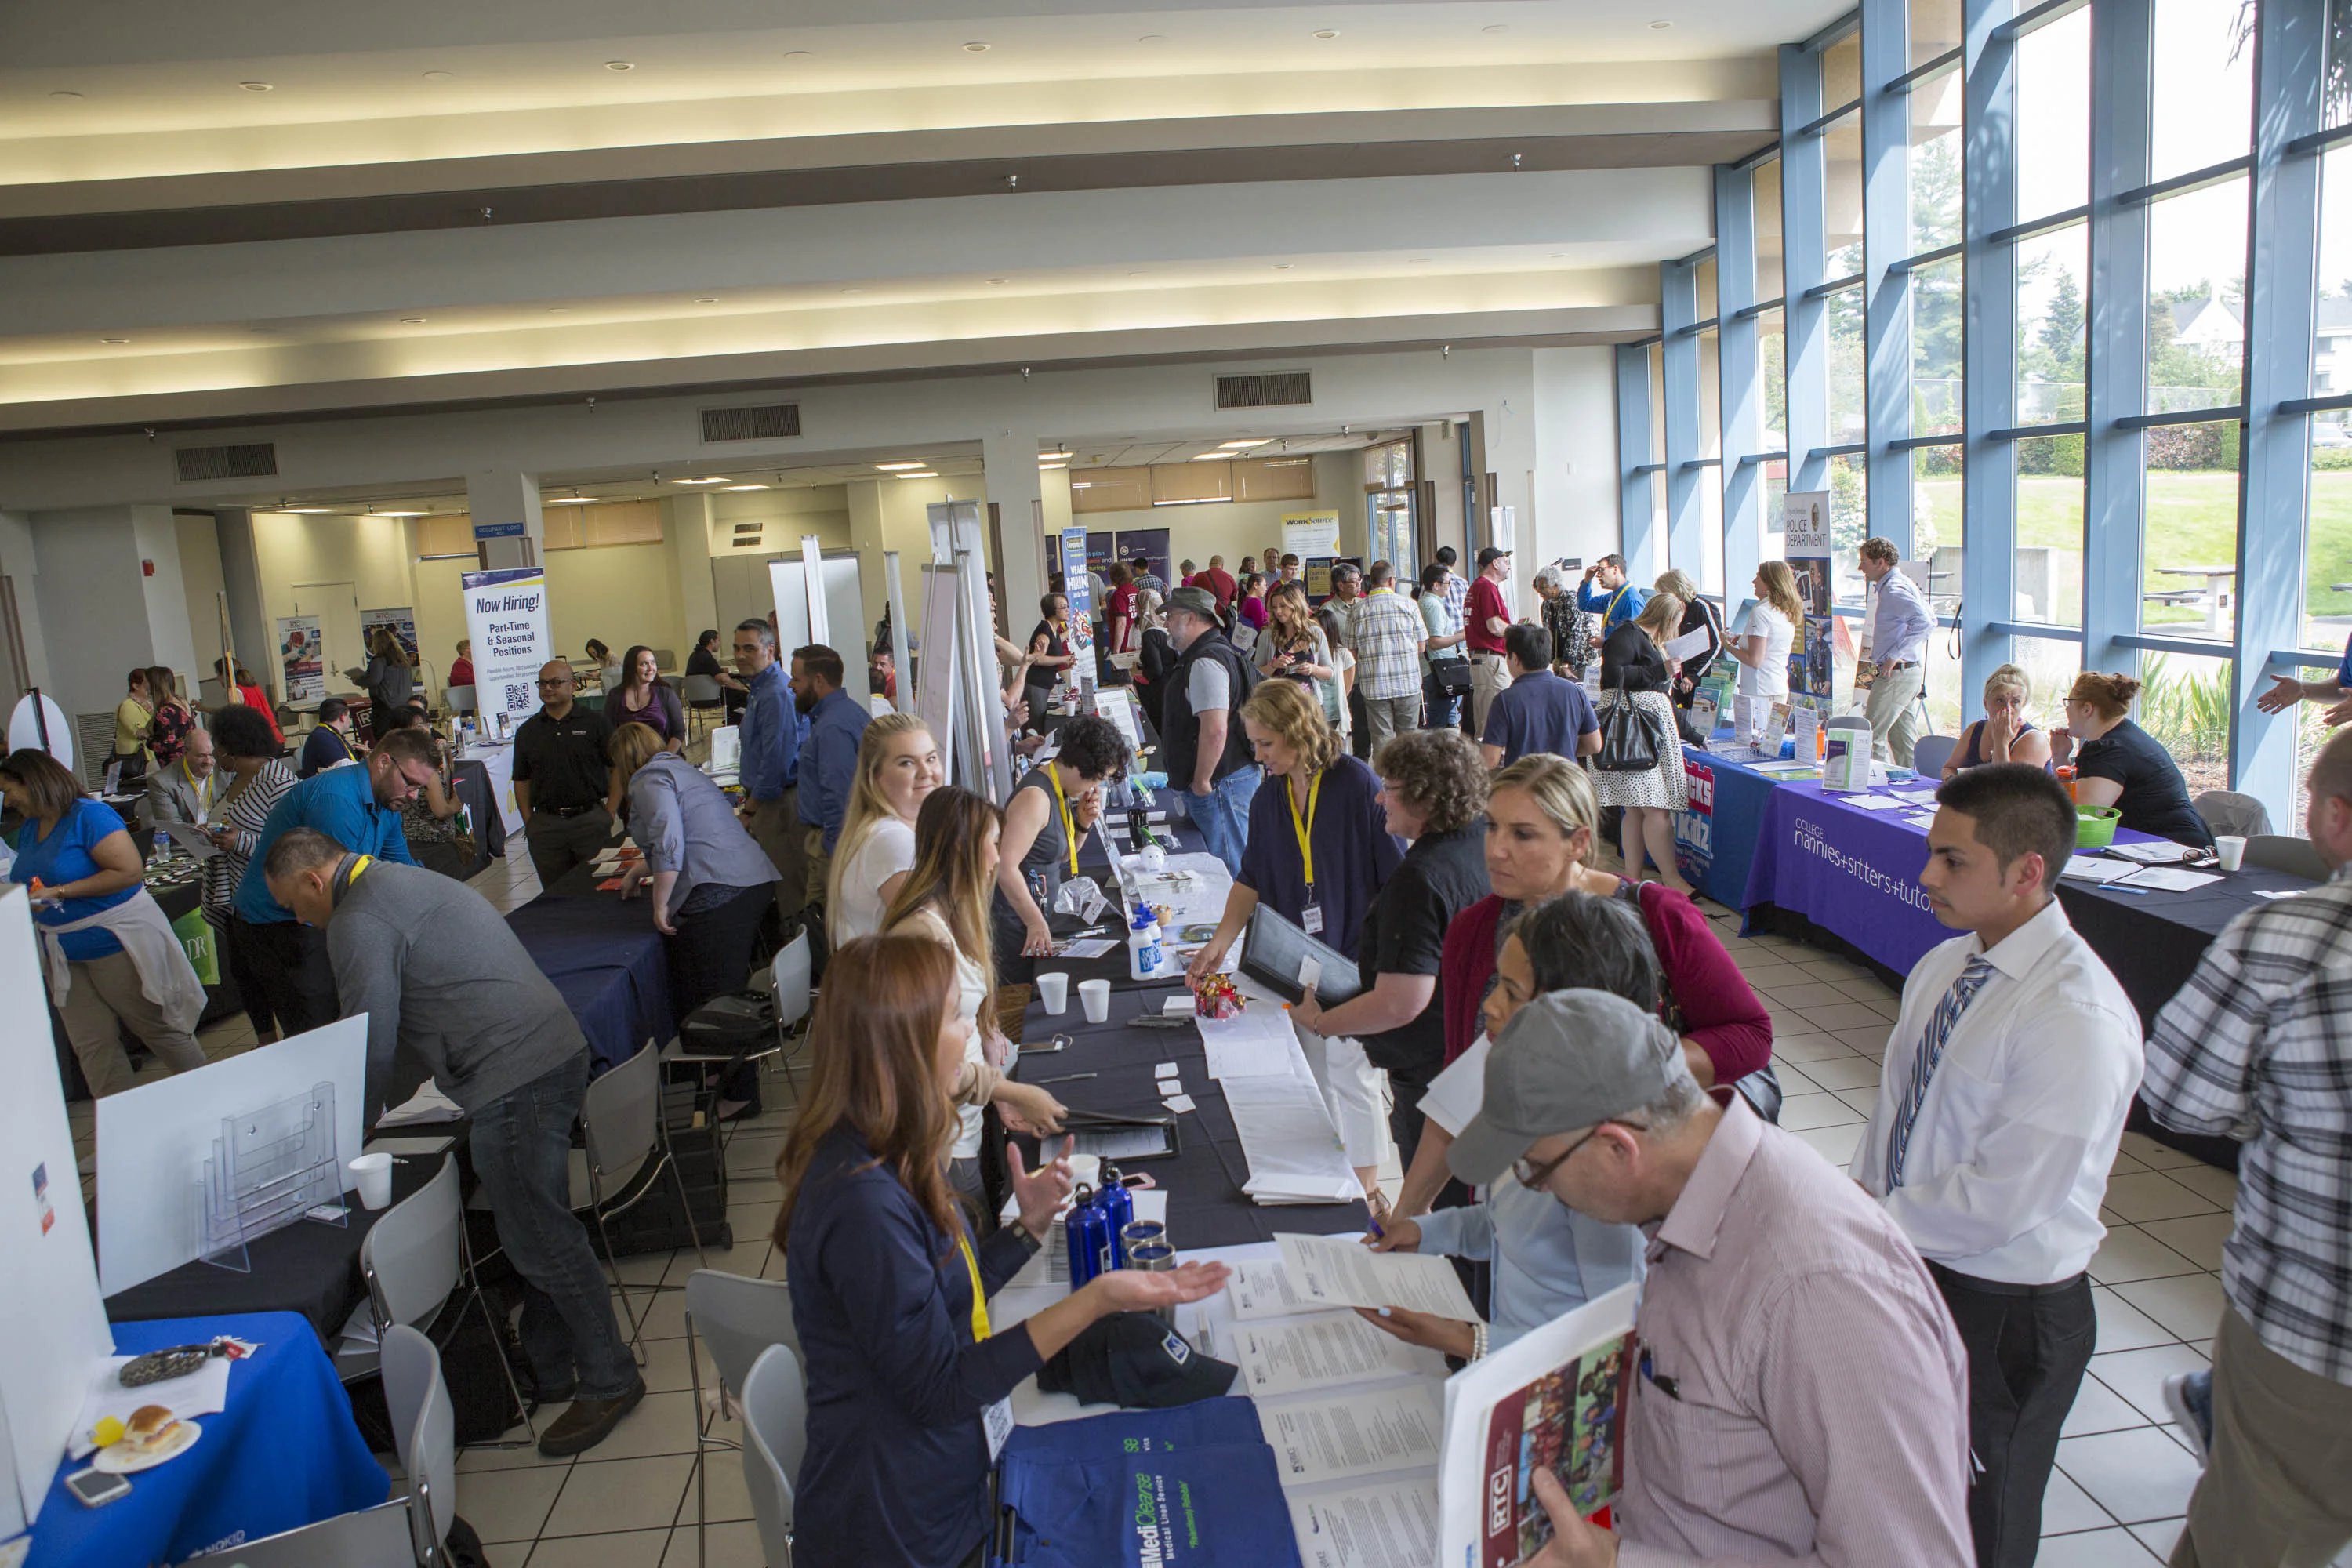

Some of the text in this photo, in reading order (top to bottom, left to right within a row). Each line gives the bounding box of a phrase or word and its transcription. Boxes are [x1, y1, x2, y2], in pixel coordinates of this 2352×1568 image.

[1787, 519, 1807, 532] POLICE
[1787, 534, 1826, 546] DEPARTMENT
[476, 593, 539, 614] Now Hiring!
[489, 622, 530, 633] Part-Time
[487, 631, 535, 646] & Seasonal
[493, 645, 532, 657] Positions
[1795, 818, 1824, 840] COLLEGE
[1492, 1472, 1508, 1530] RTC
[1135, 1472, 1162, 1563] MediCleanse
[1155, 1475, 1175, 1560] Medical Linen Service
